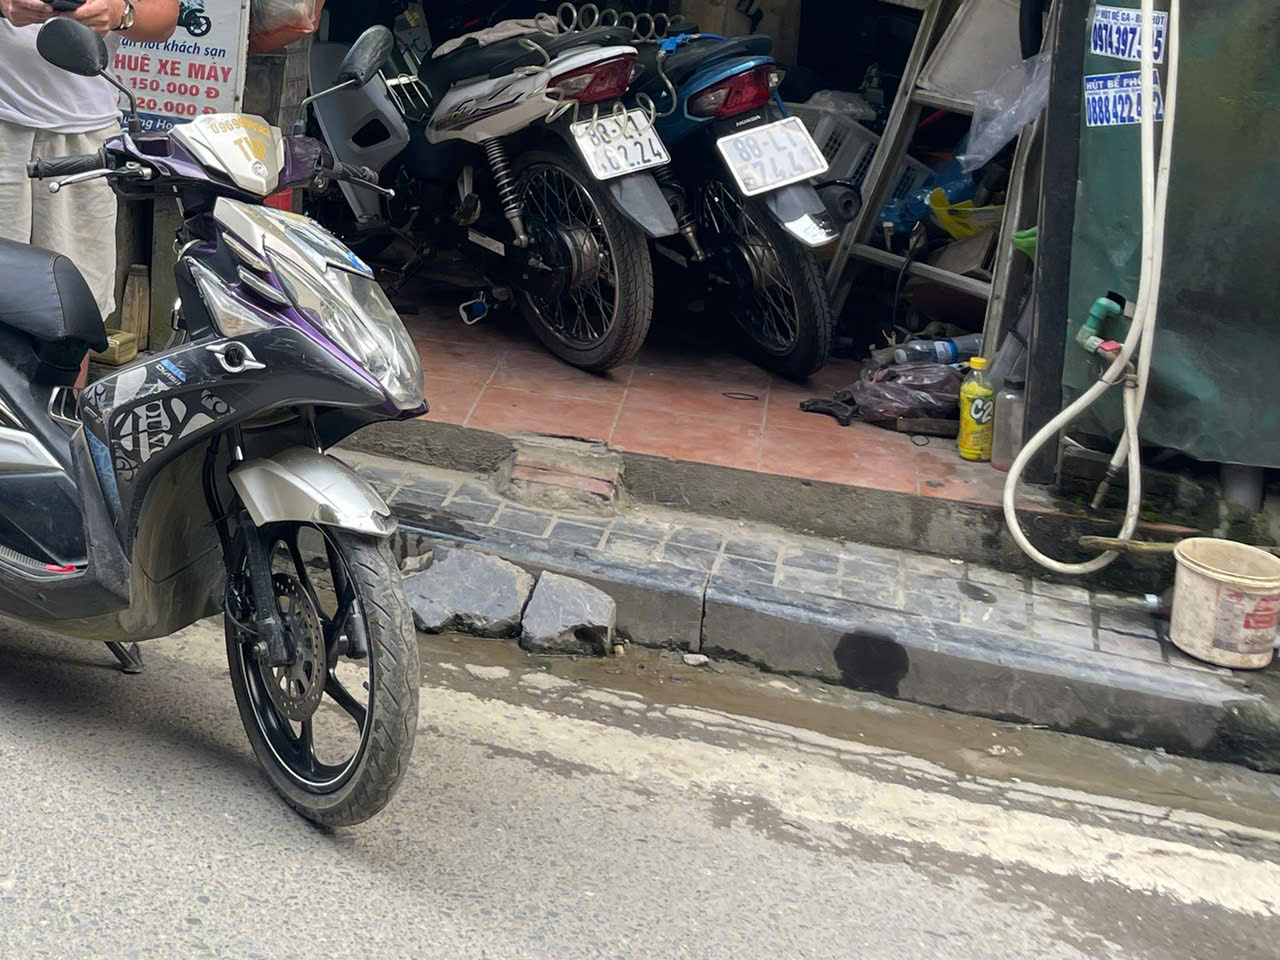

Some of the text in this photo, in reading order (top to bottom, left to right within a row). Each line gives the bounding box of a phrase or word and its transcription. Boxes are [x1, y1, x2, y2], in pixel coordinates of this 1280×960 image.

[163, 39, 200, 55] khách
[204, 47, 226, 59] sạn
[1093, 23, 1163, 61] 0974.397.55
[114, 53, 232, 83] HUÊ XE MÁY
[130, 77, 220, 99] 150.000 Đ
[971, 398, 993, 425] C2
